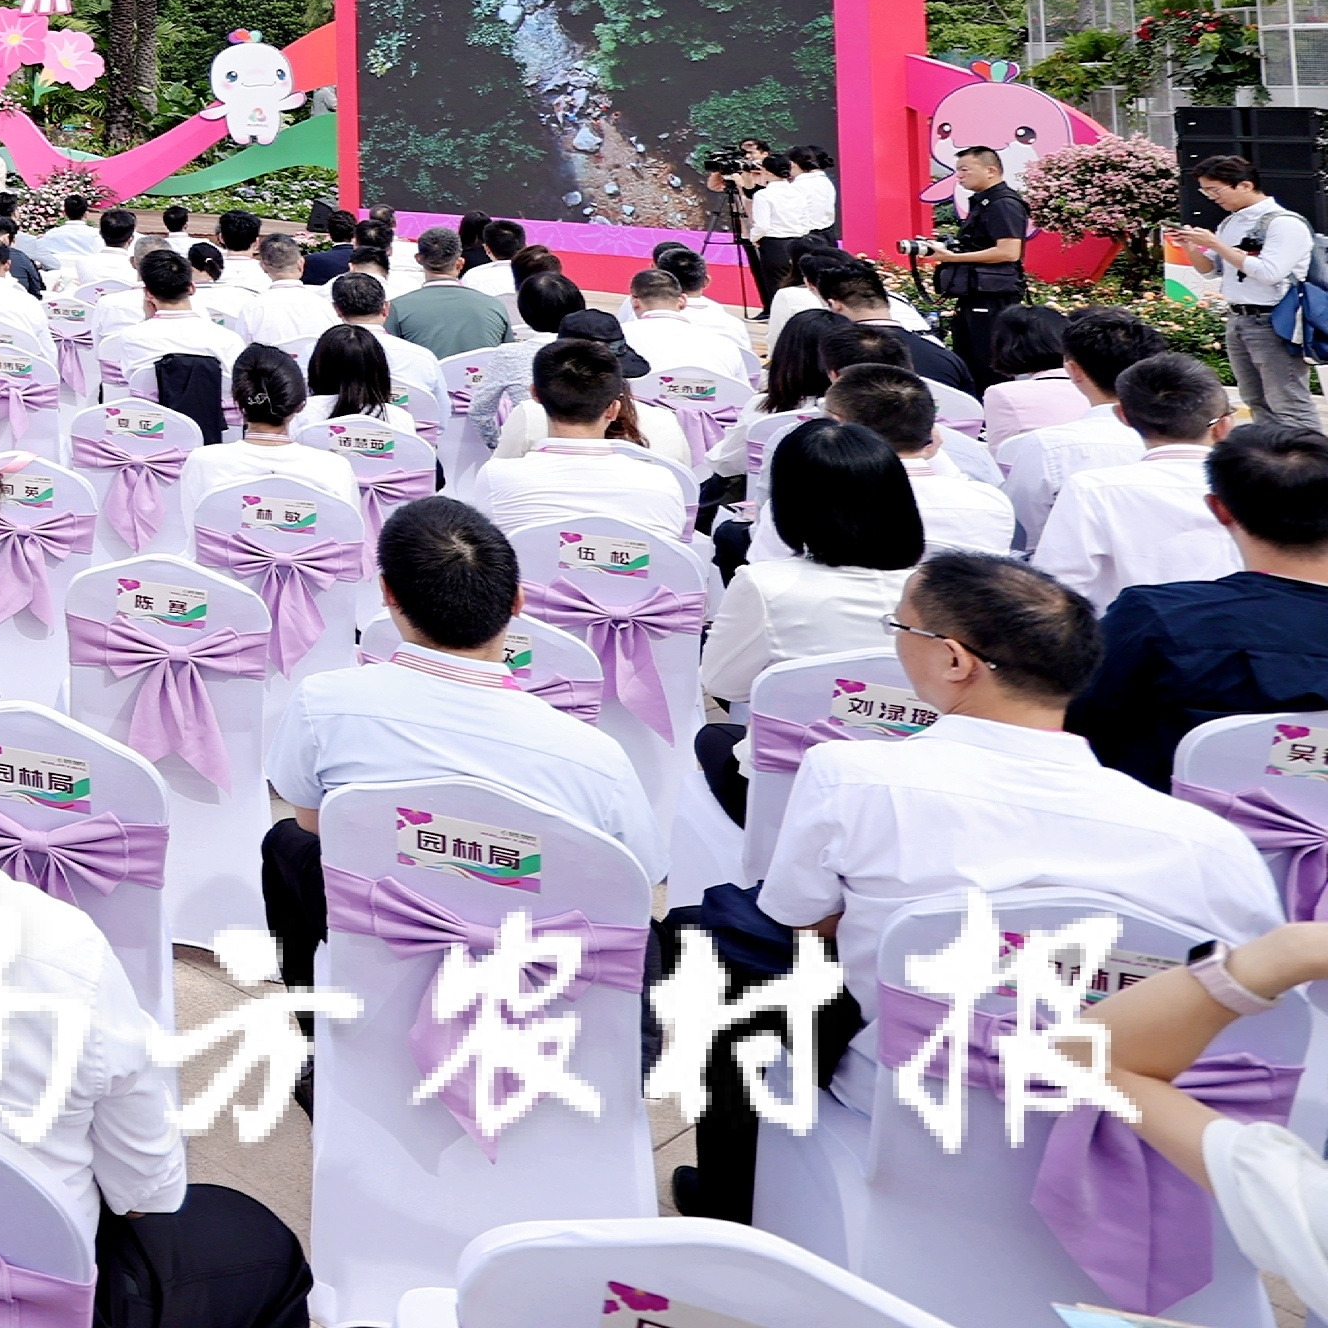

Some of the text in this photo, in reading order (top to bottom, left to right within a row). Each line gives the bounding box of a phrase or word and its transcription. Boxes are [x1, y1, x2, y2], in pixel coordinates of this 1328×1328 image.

[256, 508, 301, 523] 林敏
[576, 546, 632, 565] 伍松
[417, 830, 520, 870] 园林局
